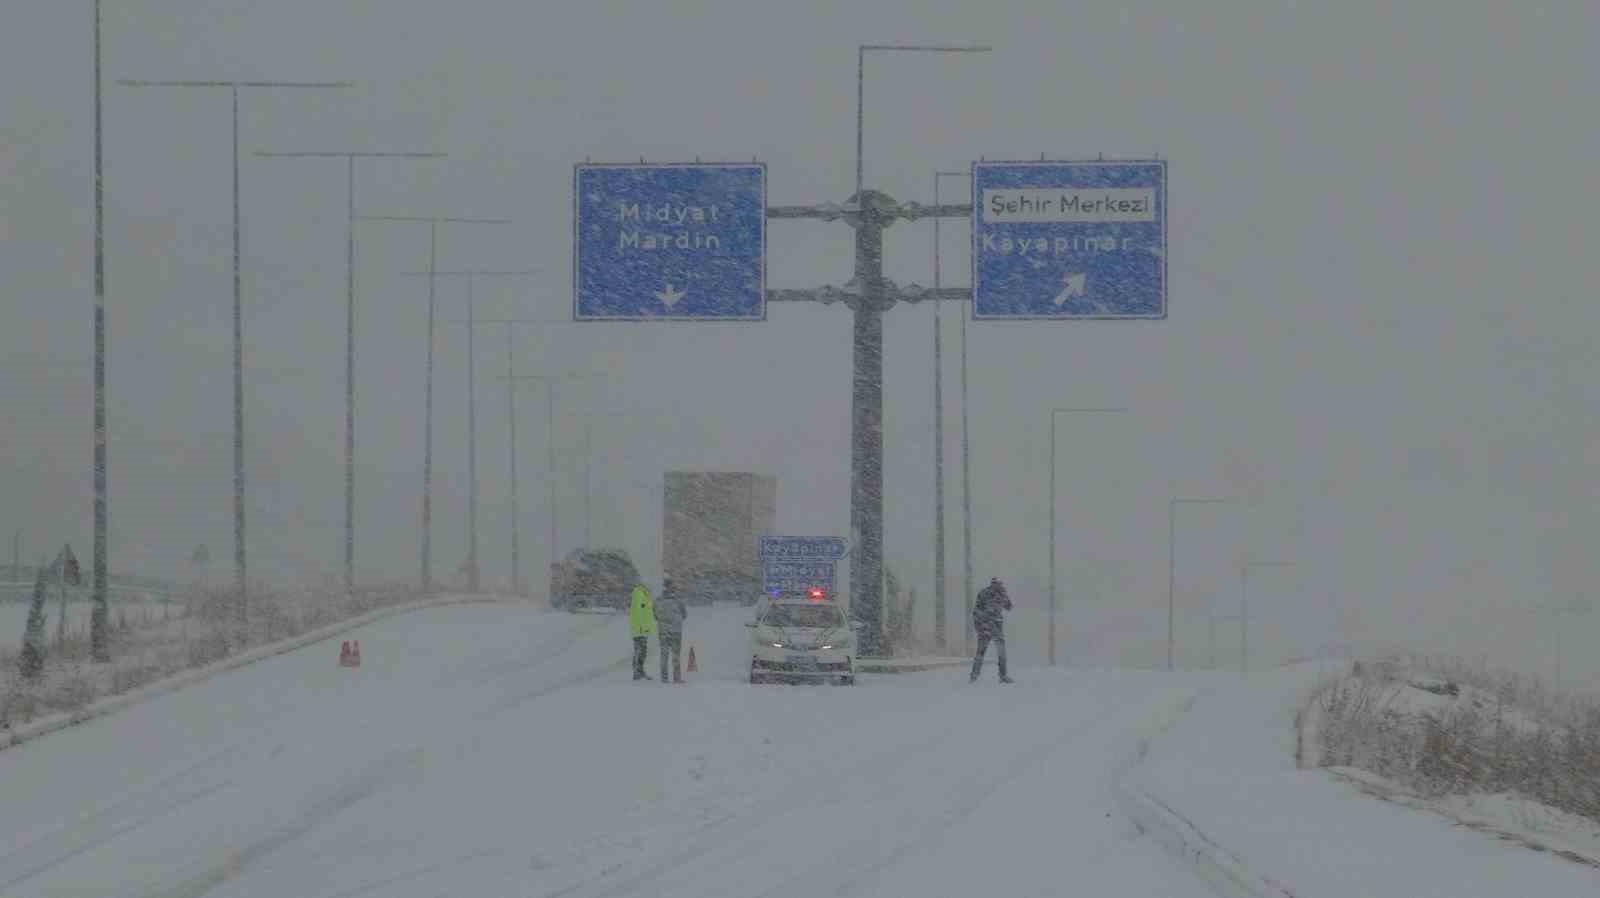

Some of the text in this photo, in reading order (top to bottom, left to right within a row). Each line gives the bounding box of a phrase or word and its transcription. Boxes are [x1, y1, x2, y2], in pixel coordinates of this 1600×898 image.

[620, 203, 720, 224] Midyat
[991, 194, 1150, 216] Şehir Merkezi
[620, 230, 721, 249] Mardin
